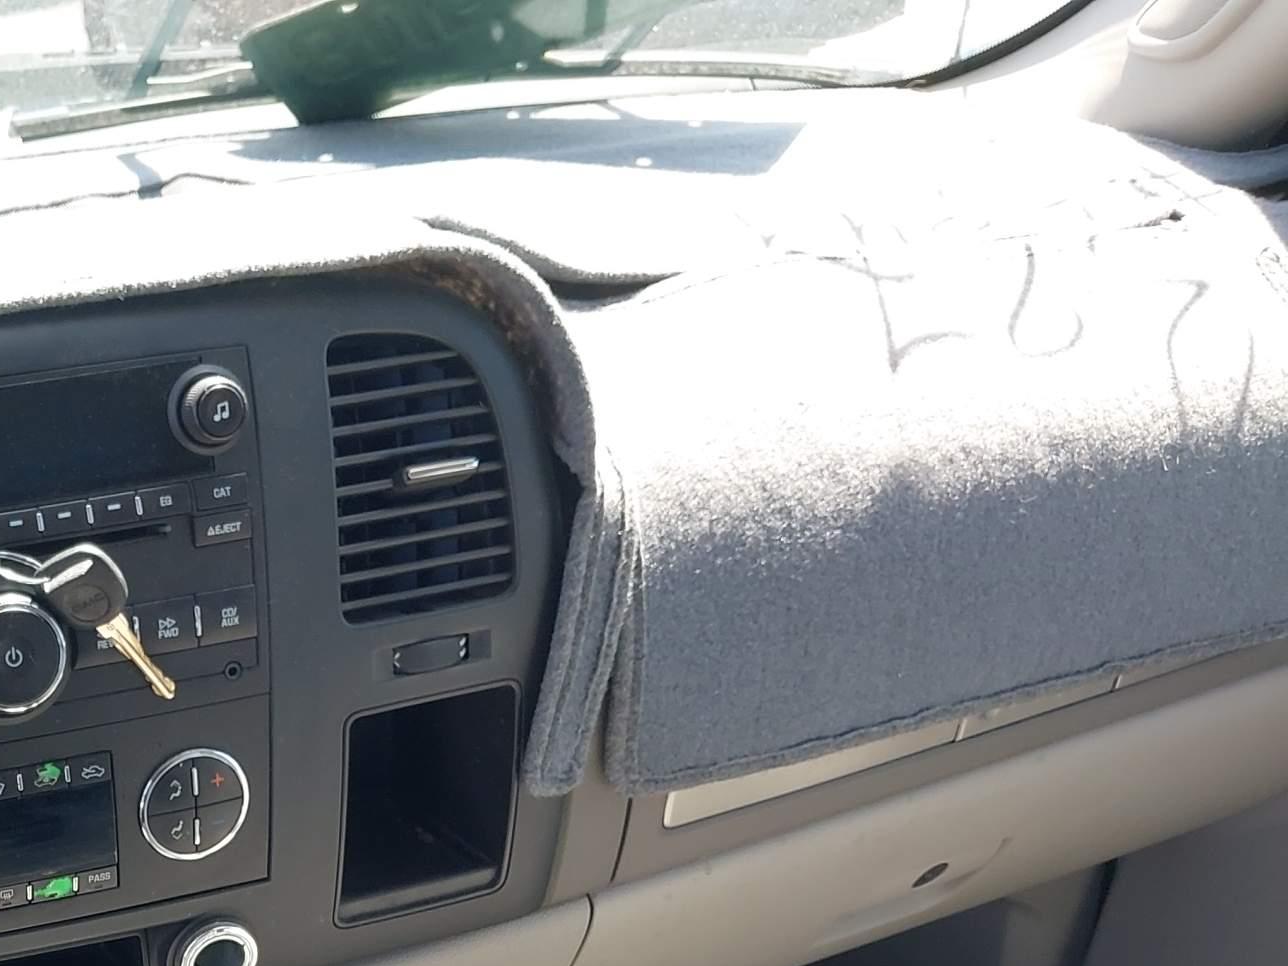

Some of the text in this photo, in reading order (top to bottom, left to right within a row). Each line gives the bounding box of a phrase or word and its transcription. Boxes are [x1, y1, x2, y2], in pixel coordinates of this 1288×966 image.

[213, 486, 232, 499] CAT
[215, 521, 242, 535] EJECT
[221, 607, 238, 618] CD/
[221, 616, 240, 628] AUX
[158, 626, 179, 639] FWD
[88, 872, 111, 884] PASS
